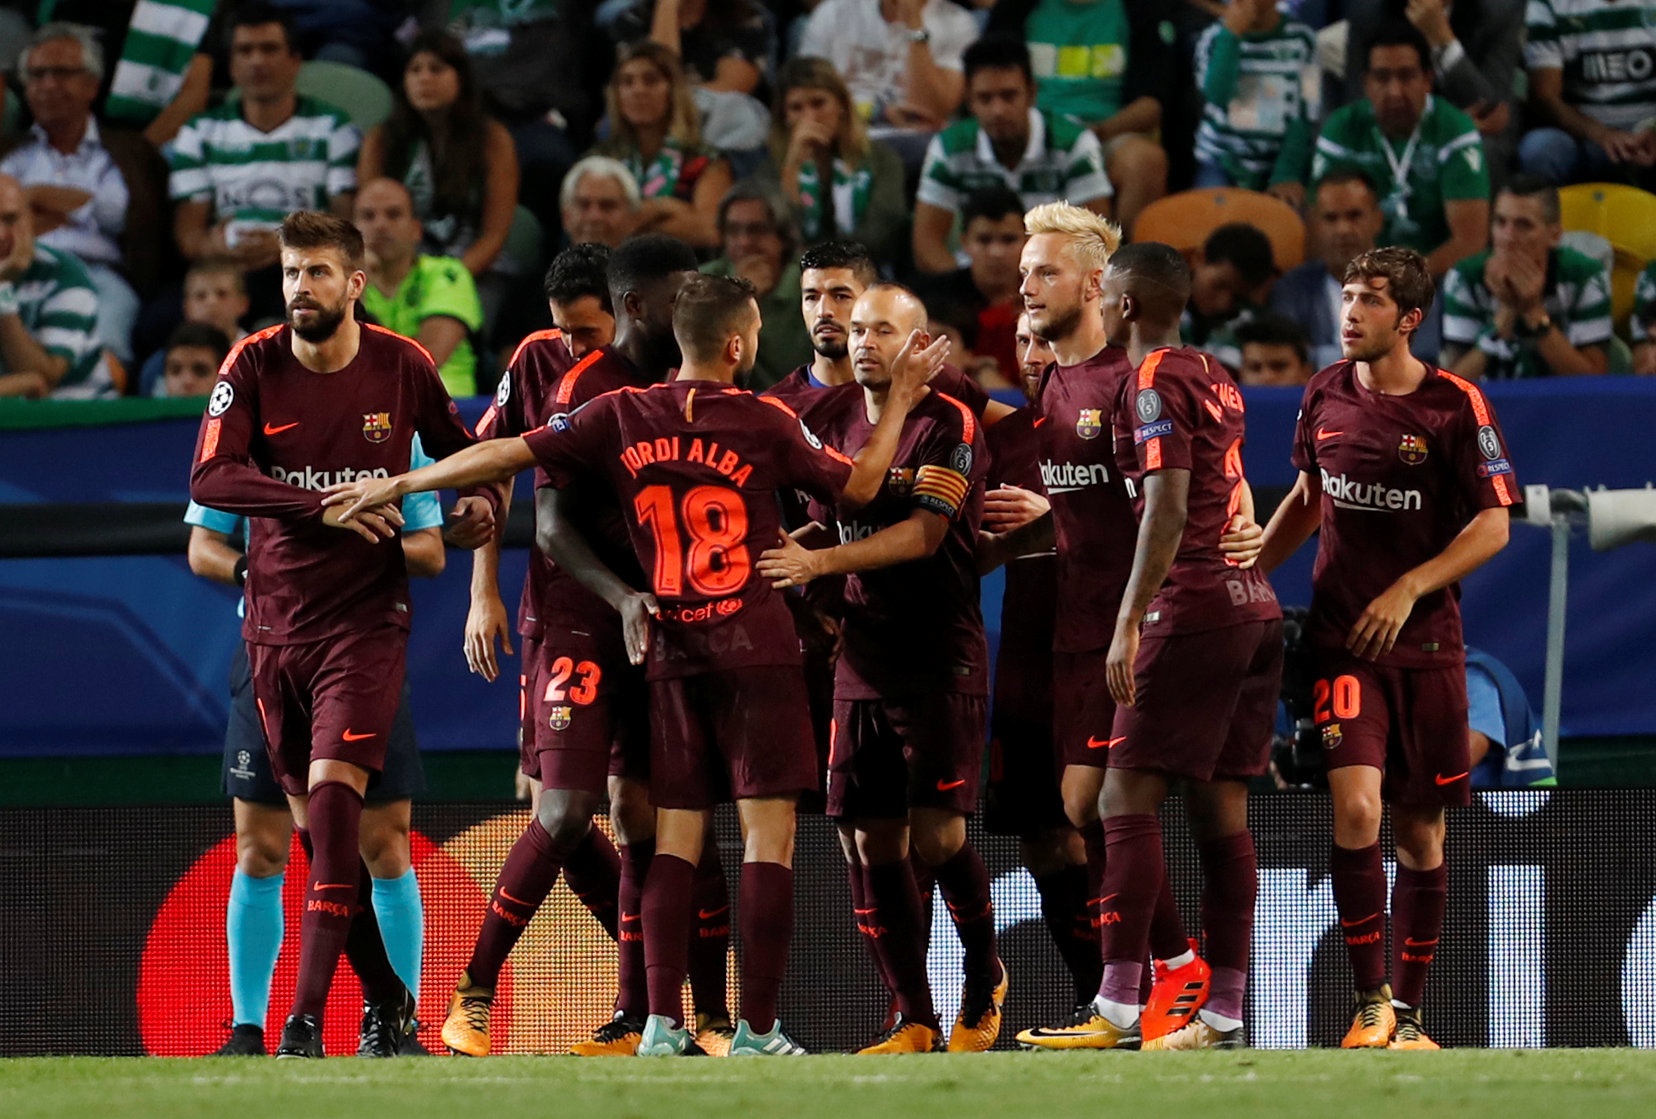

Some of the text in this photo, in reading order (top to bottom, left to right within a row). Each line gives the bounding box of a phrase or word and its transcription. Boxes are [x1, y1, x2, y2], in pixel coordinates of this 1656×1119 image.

[620, 436, 753, 488] JORDI ALBA
[1038, 458, 1110, 487] akuten
[1320, 466, 1422, 511] Rakuten
[633, 485, 752, 597] 18
[543, 656, 602, 705] 23
[1313, 674, 1361, 726] 20
